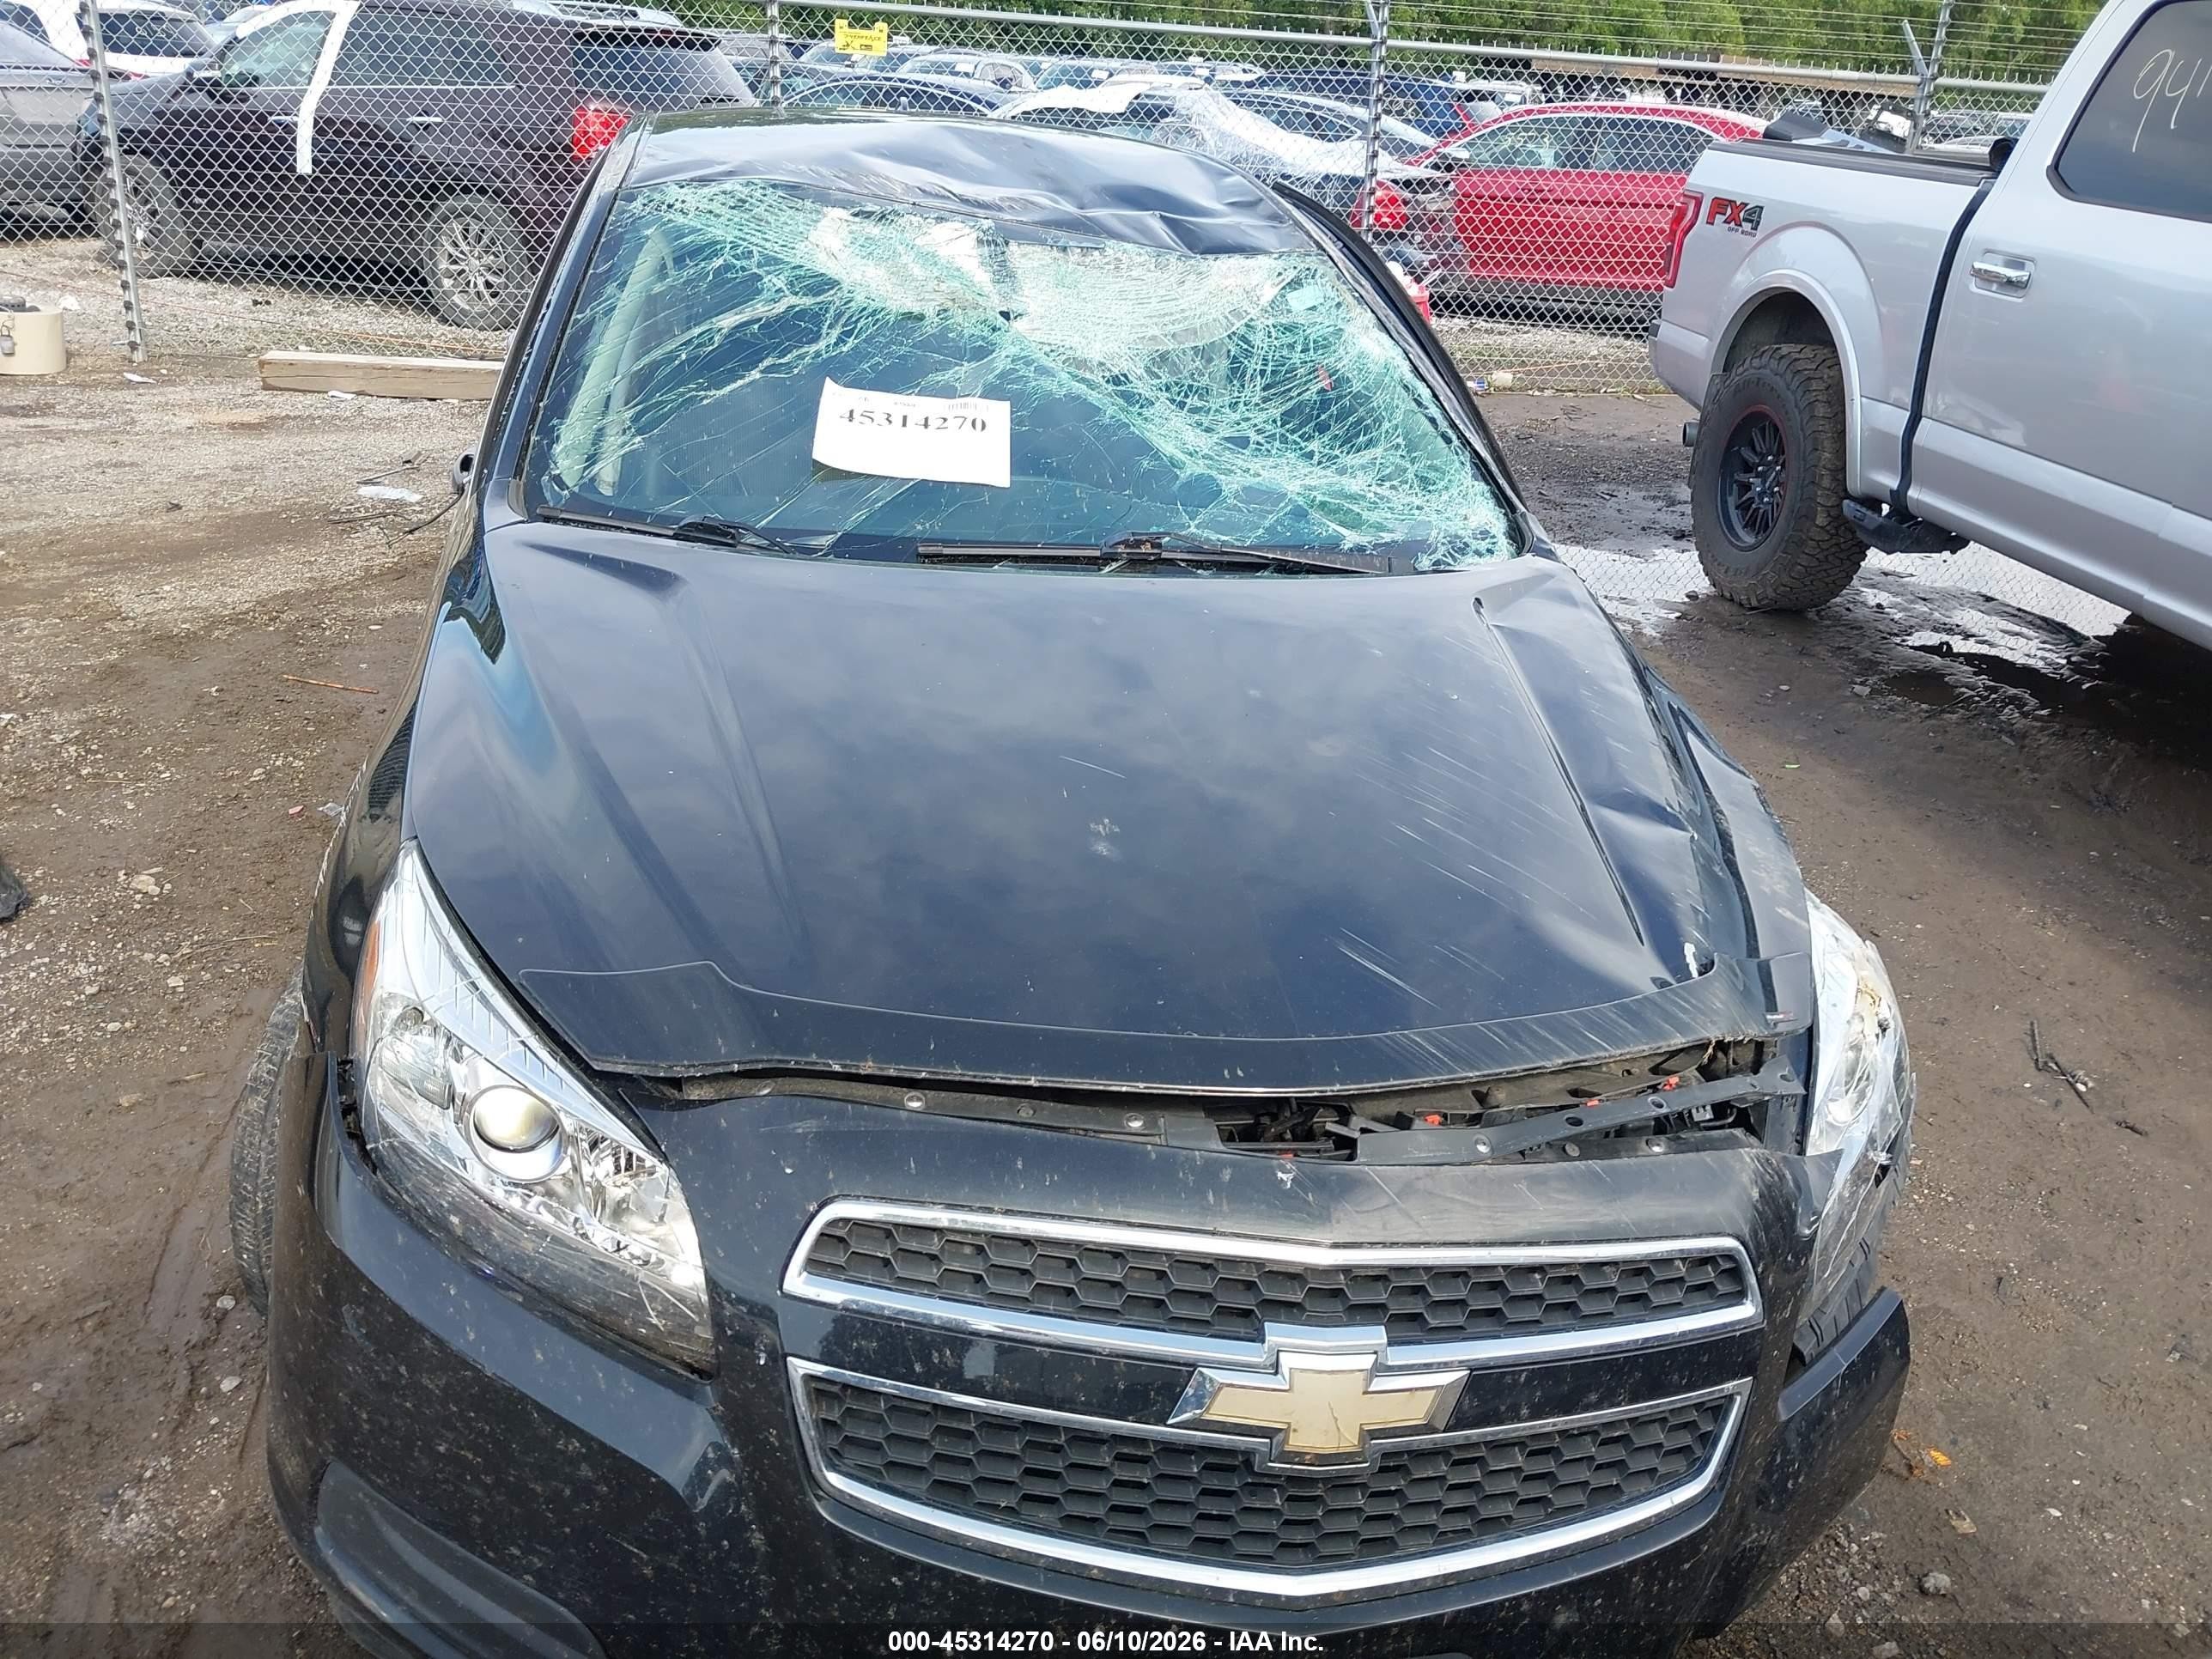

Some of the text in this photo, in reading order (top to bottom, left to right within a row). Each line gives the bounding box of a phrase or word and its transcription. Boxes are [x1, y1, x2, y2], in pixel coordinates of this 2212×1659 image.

[1705, 196, 1765, 231] FX4
[1741, 229, 1757, 238] ROAD
[838, 408, 988, 432] 45314270
